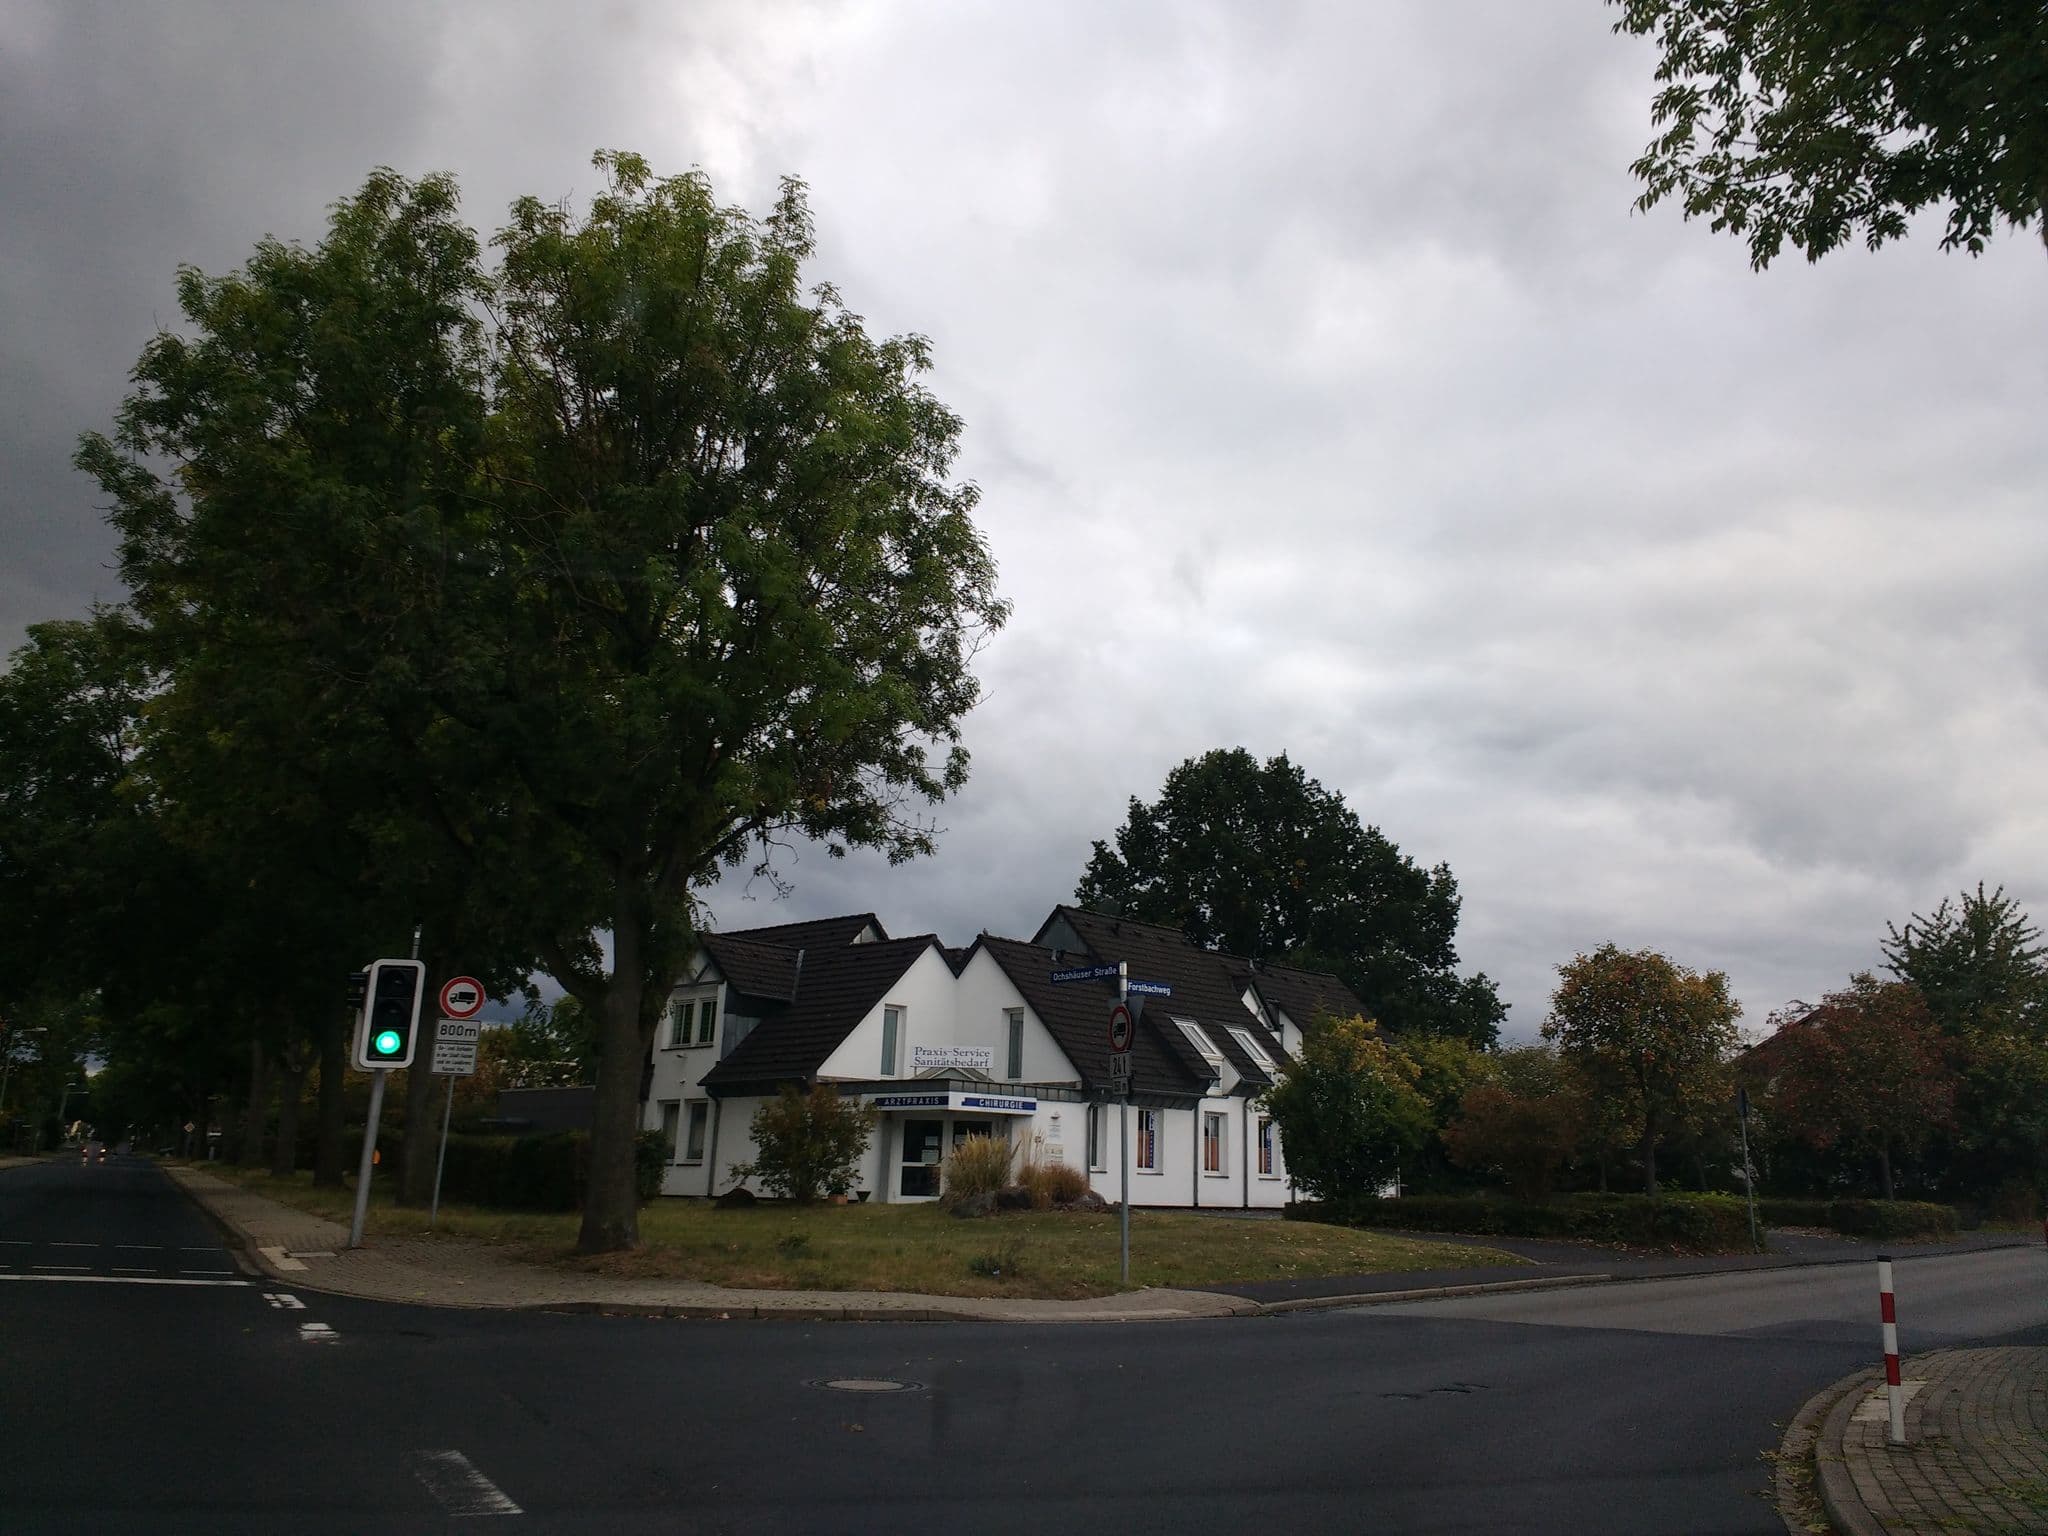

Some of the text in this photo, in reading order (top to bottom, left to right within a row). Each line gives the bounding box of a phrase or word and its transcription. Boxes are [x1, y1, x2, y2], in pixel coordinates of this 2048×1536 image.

[1053, 966, 1117, 981] Ochshäuser Straße
[1128, 982, 1171, 996] Forstbachweg
[914, 1046, 990, 1058] Praxis-Service
[914, 1056, 989, 1068] Sanitätsbedarf
[884, 1096, 940, 1105] ARZTPRAXIS
[979, 1098, 1024, 1110] CHIRURGIE
